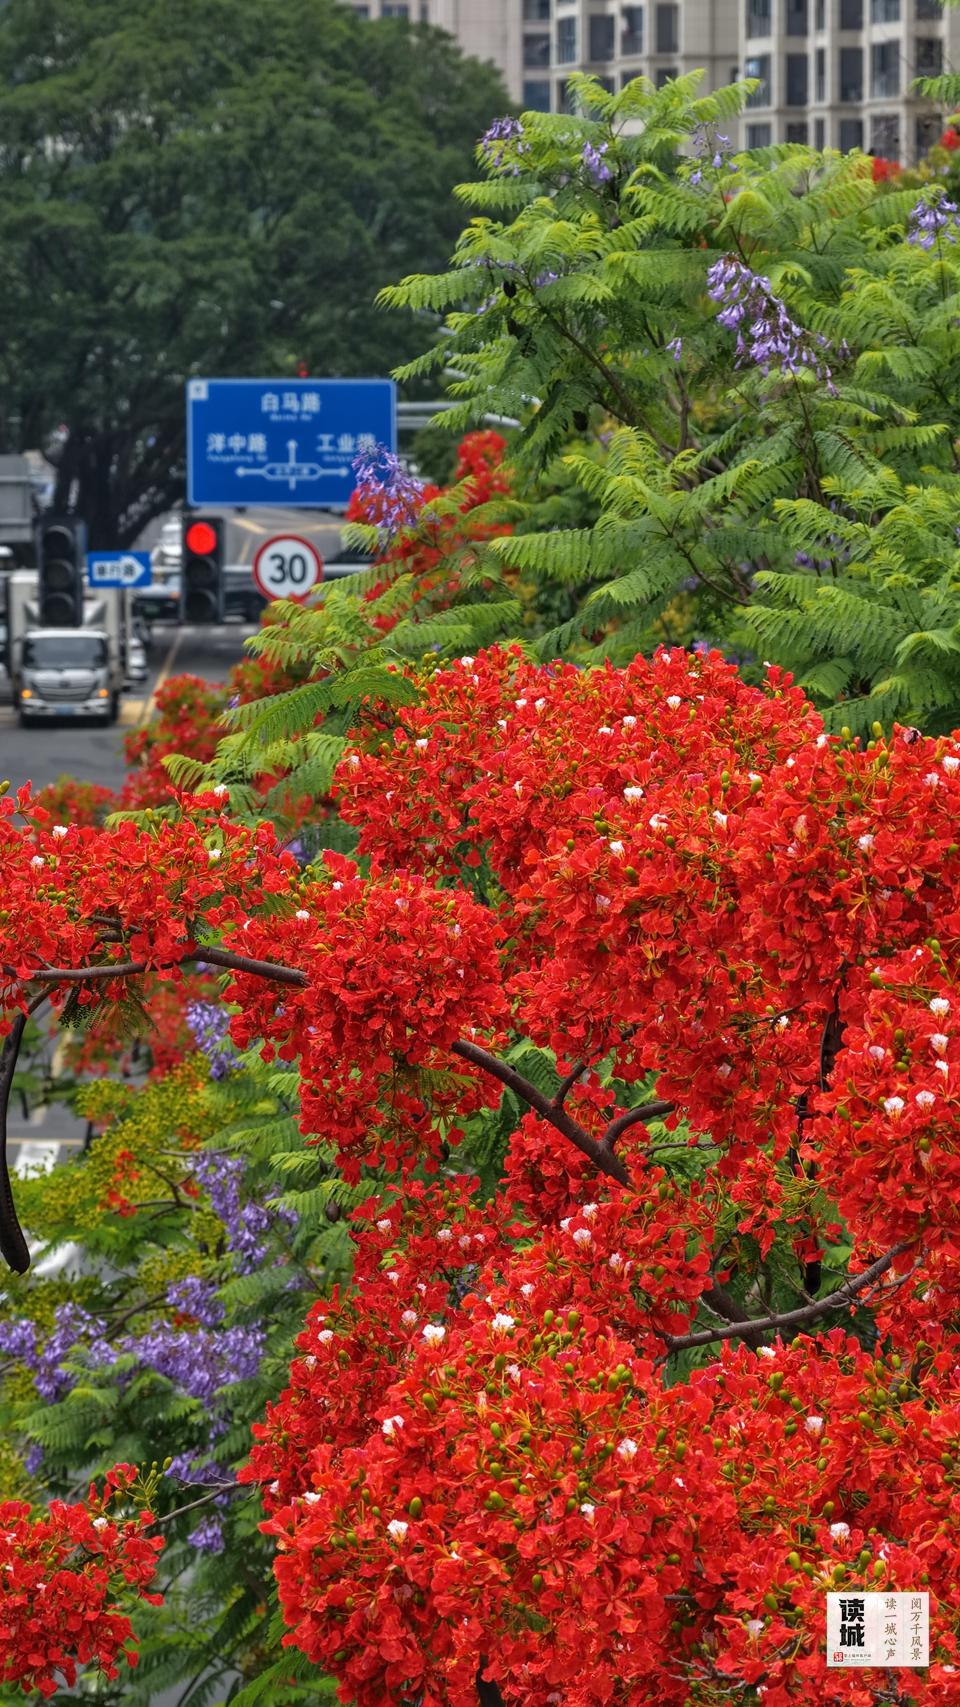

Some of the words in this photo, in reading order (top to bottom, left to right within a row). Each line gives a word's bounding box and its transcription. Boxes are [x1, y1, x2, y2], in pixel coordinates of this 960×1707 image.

[261, 392, 321, 413] 白马路
[207, 433, 266, 453] 洋中路
[269, 553, 307, 584] 30
